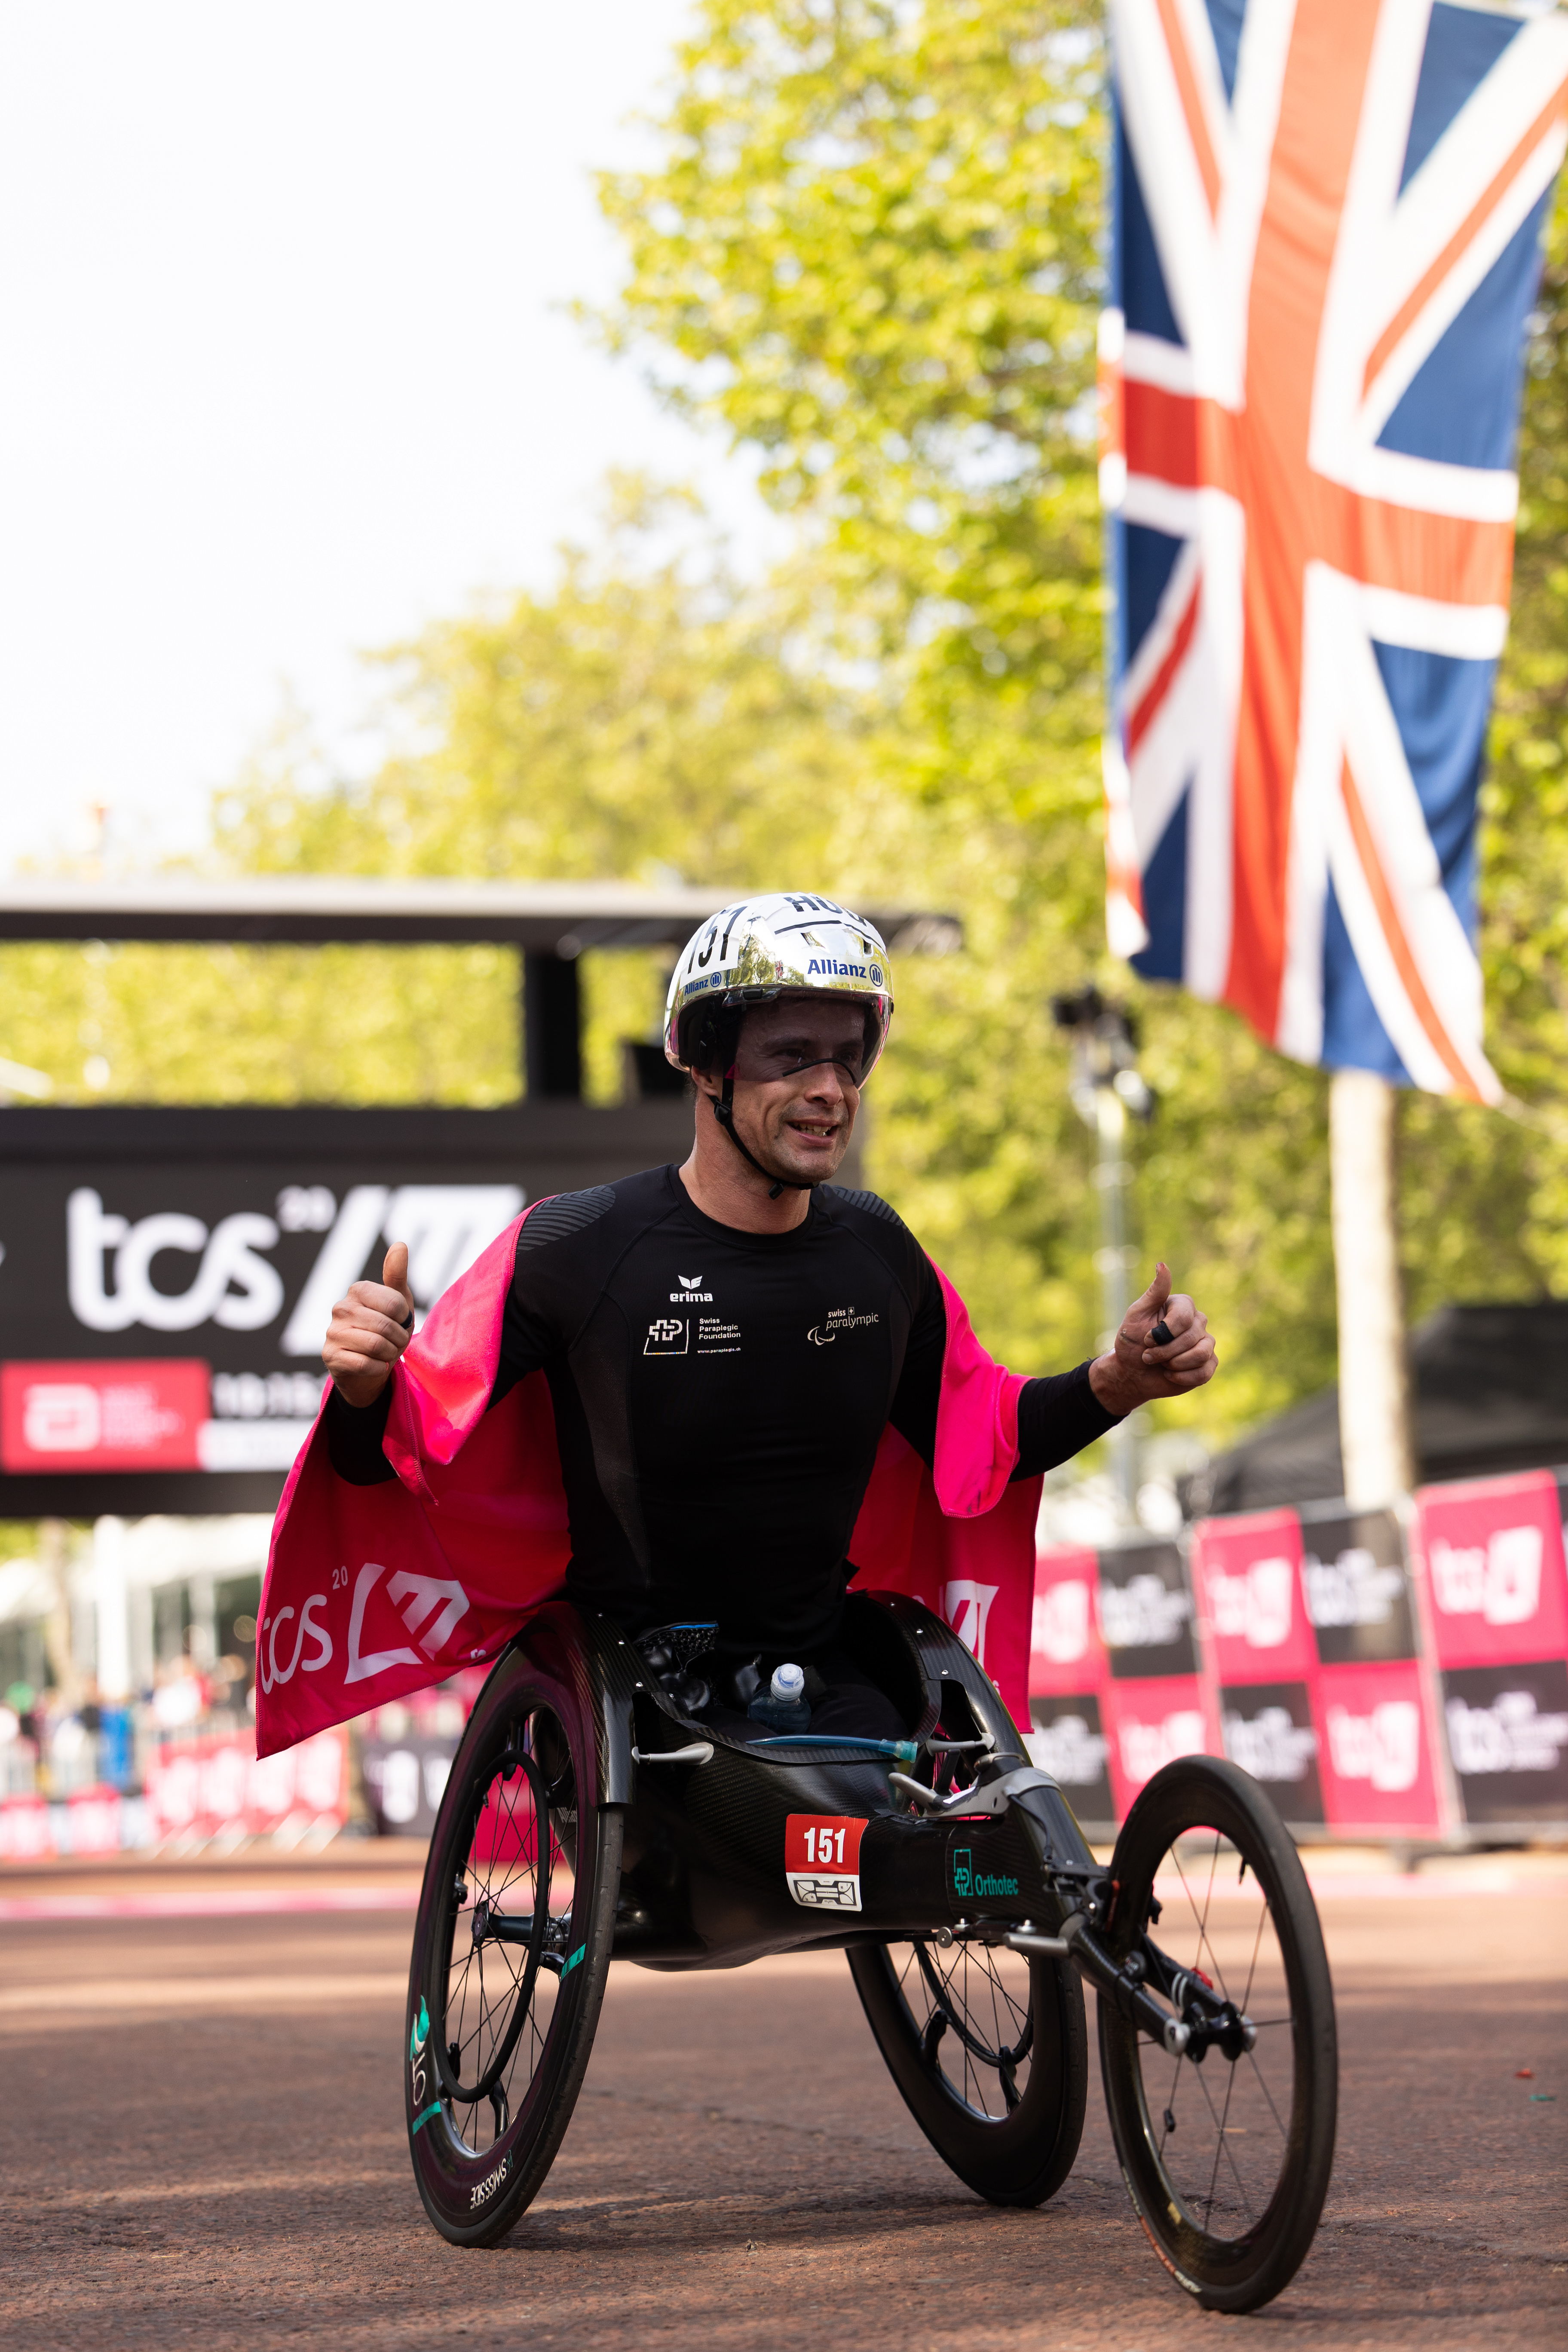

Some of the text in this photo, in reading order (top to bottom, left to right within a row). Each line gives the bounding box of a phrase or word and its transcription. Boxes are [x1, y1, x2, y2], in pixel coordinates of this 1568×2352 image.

[688, 906, 748, 974] 151
[808, 959, 867, 979] Allianz
[684, 978, 709, 996] Allianz
[67, 1186, 285, 1332] tcs
[670, 1291, 713, 1302] erima
[826, 1313, 879, 1331] paralympic
[828, 1309, 846, 1318] swiss
[332, 1565, 348, 1590] 20
[803, 1827, 846, 1863] 151
[974, 1874, 1019, 1896] Orthotec
